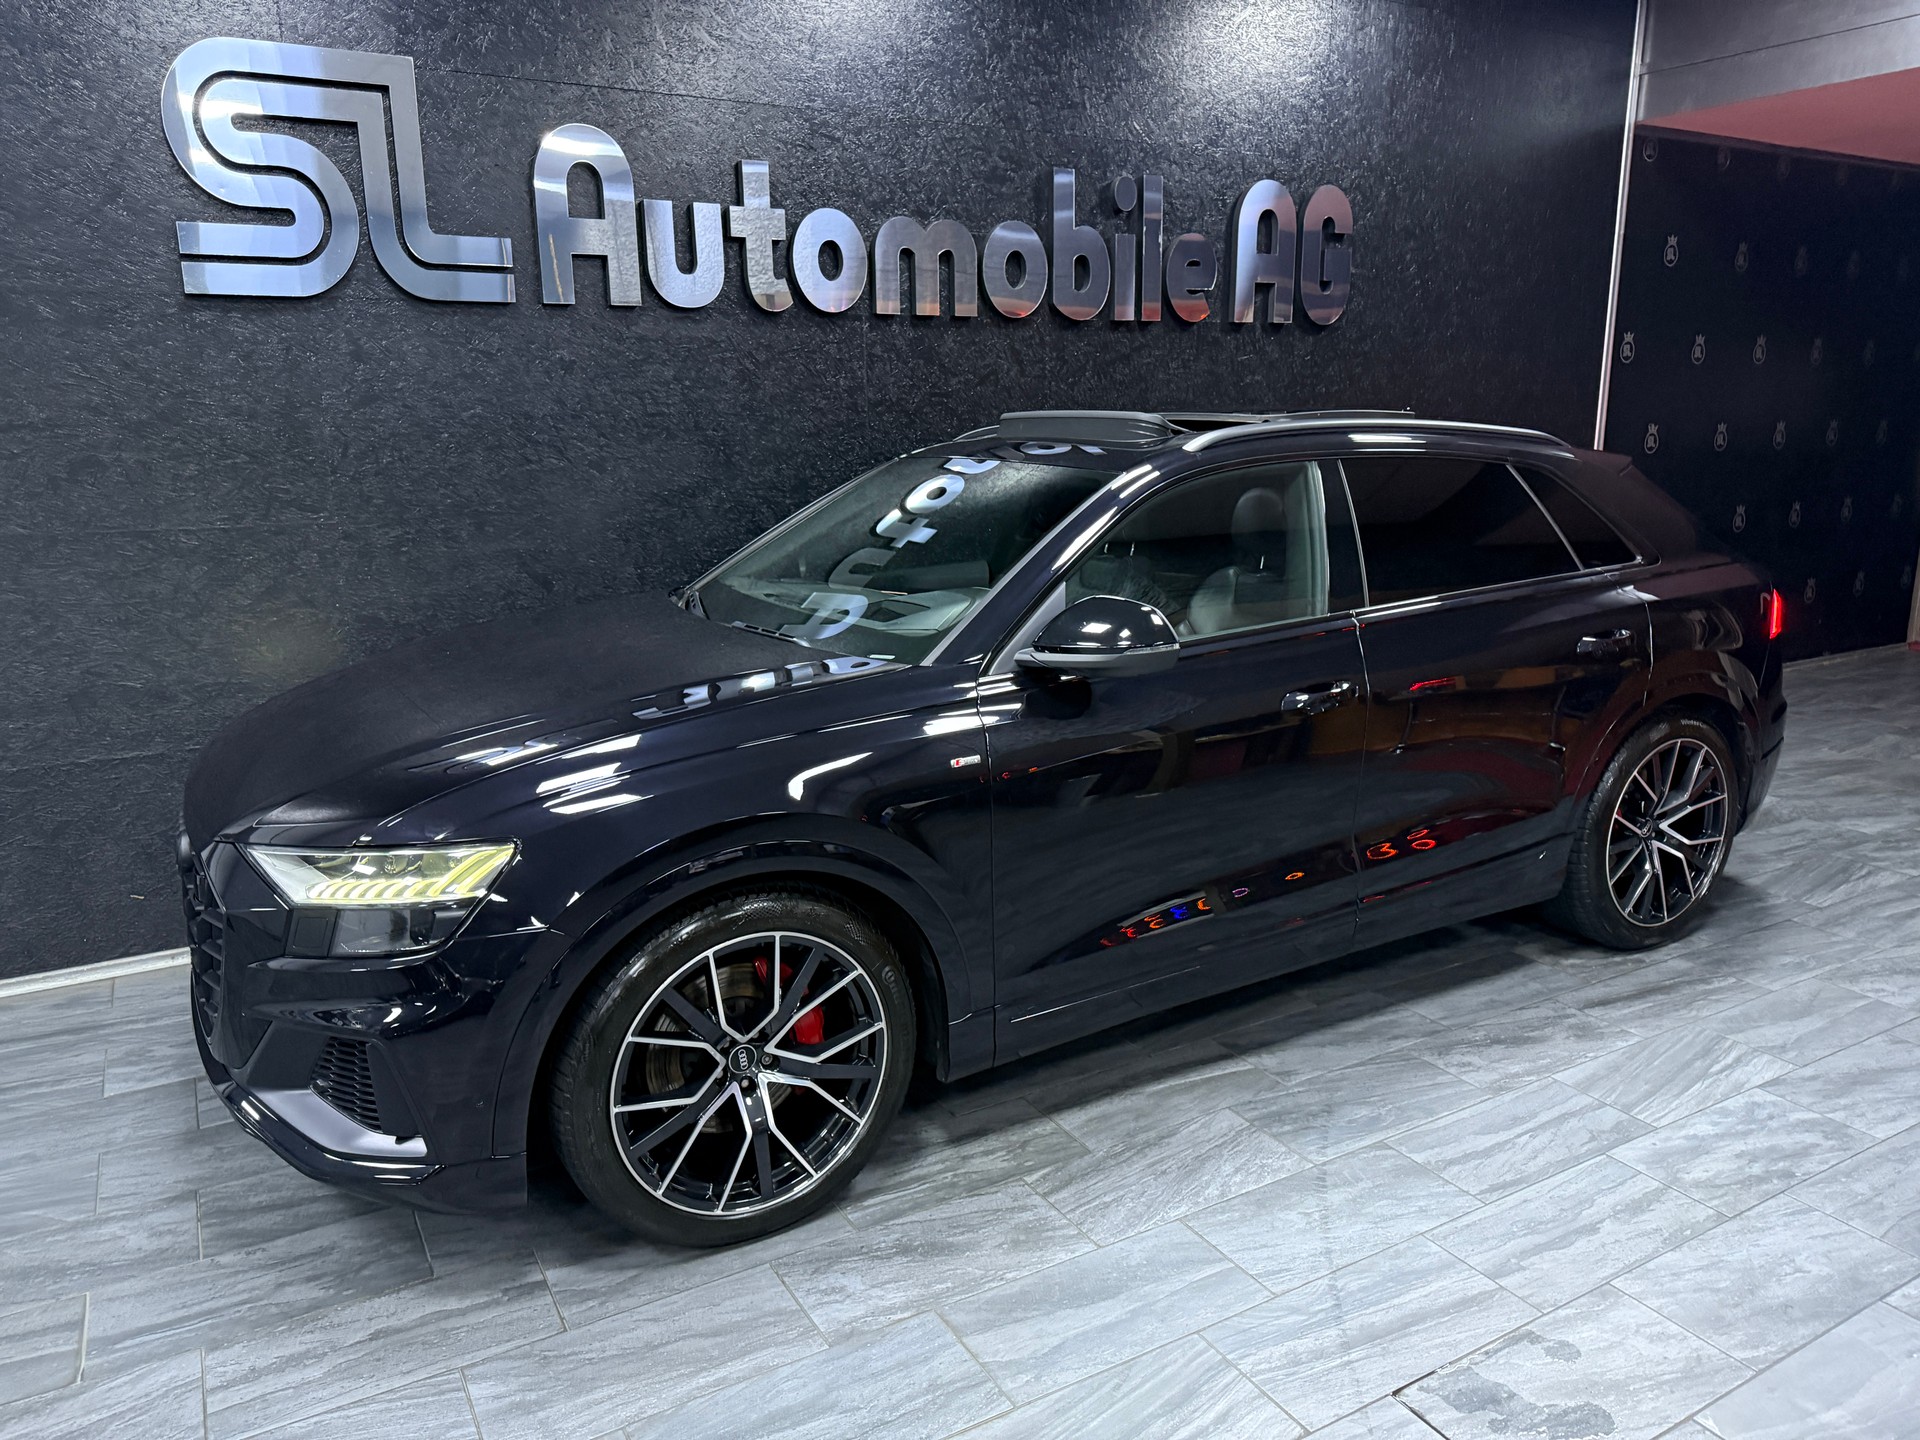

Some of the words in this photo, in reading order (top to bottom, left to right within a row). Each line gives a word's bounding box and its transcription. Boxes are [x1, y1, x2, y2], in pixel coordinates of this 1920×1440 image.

[161, 36, 516, 303] SL
[532, 123, 1219, 323] Automobile
[1229, 178, 1354, 326] AG
